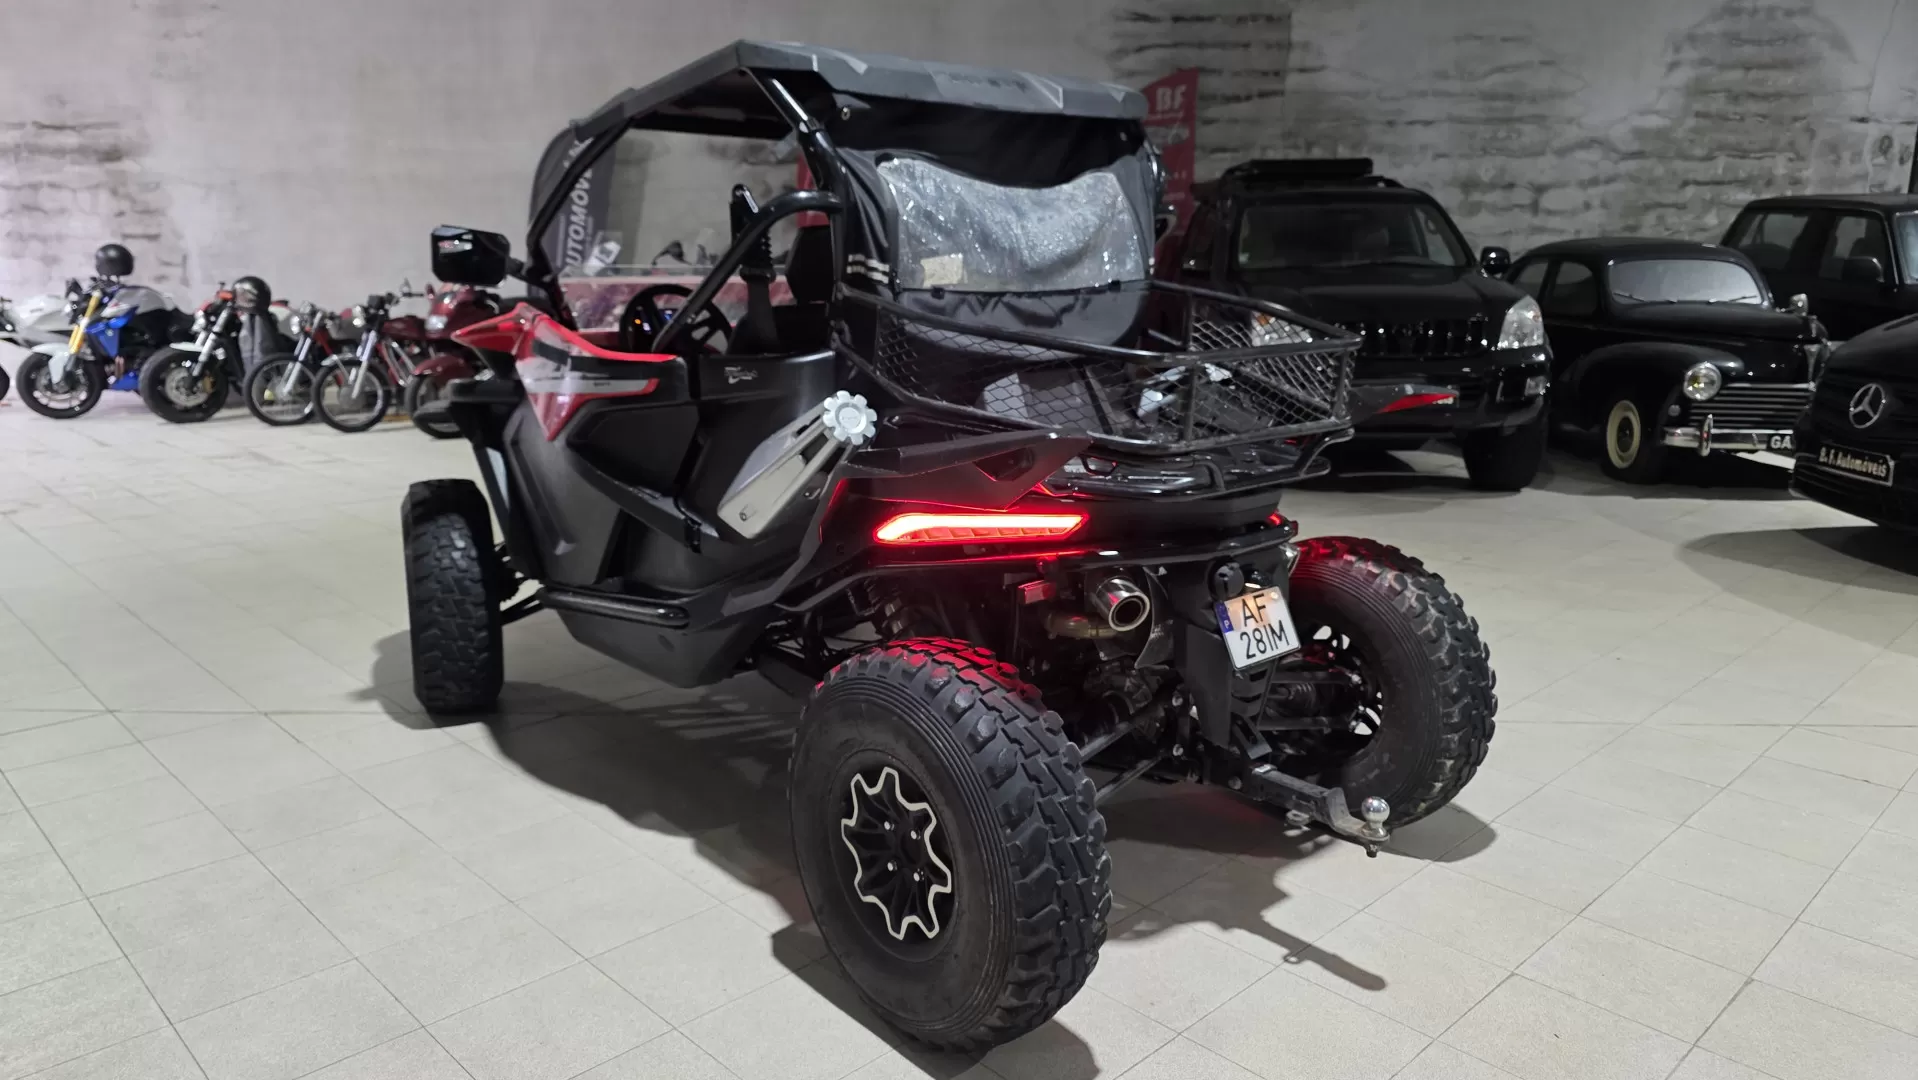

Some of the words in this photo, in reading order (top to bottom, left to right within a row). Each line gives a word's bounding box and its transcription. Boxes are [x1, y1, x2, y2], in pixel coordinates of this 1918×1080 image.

[1155, 84, 1188, 112] BF
[1241, 593, 1267, 627] AF
[1240, 620, 1290, 659] 28IM
